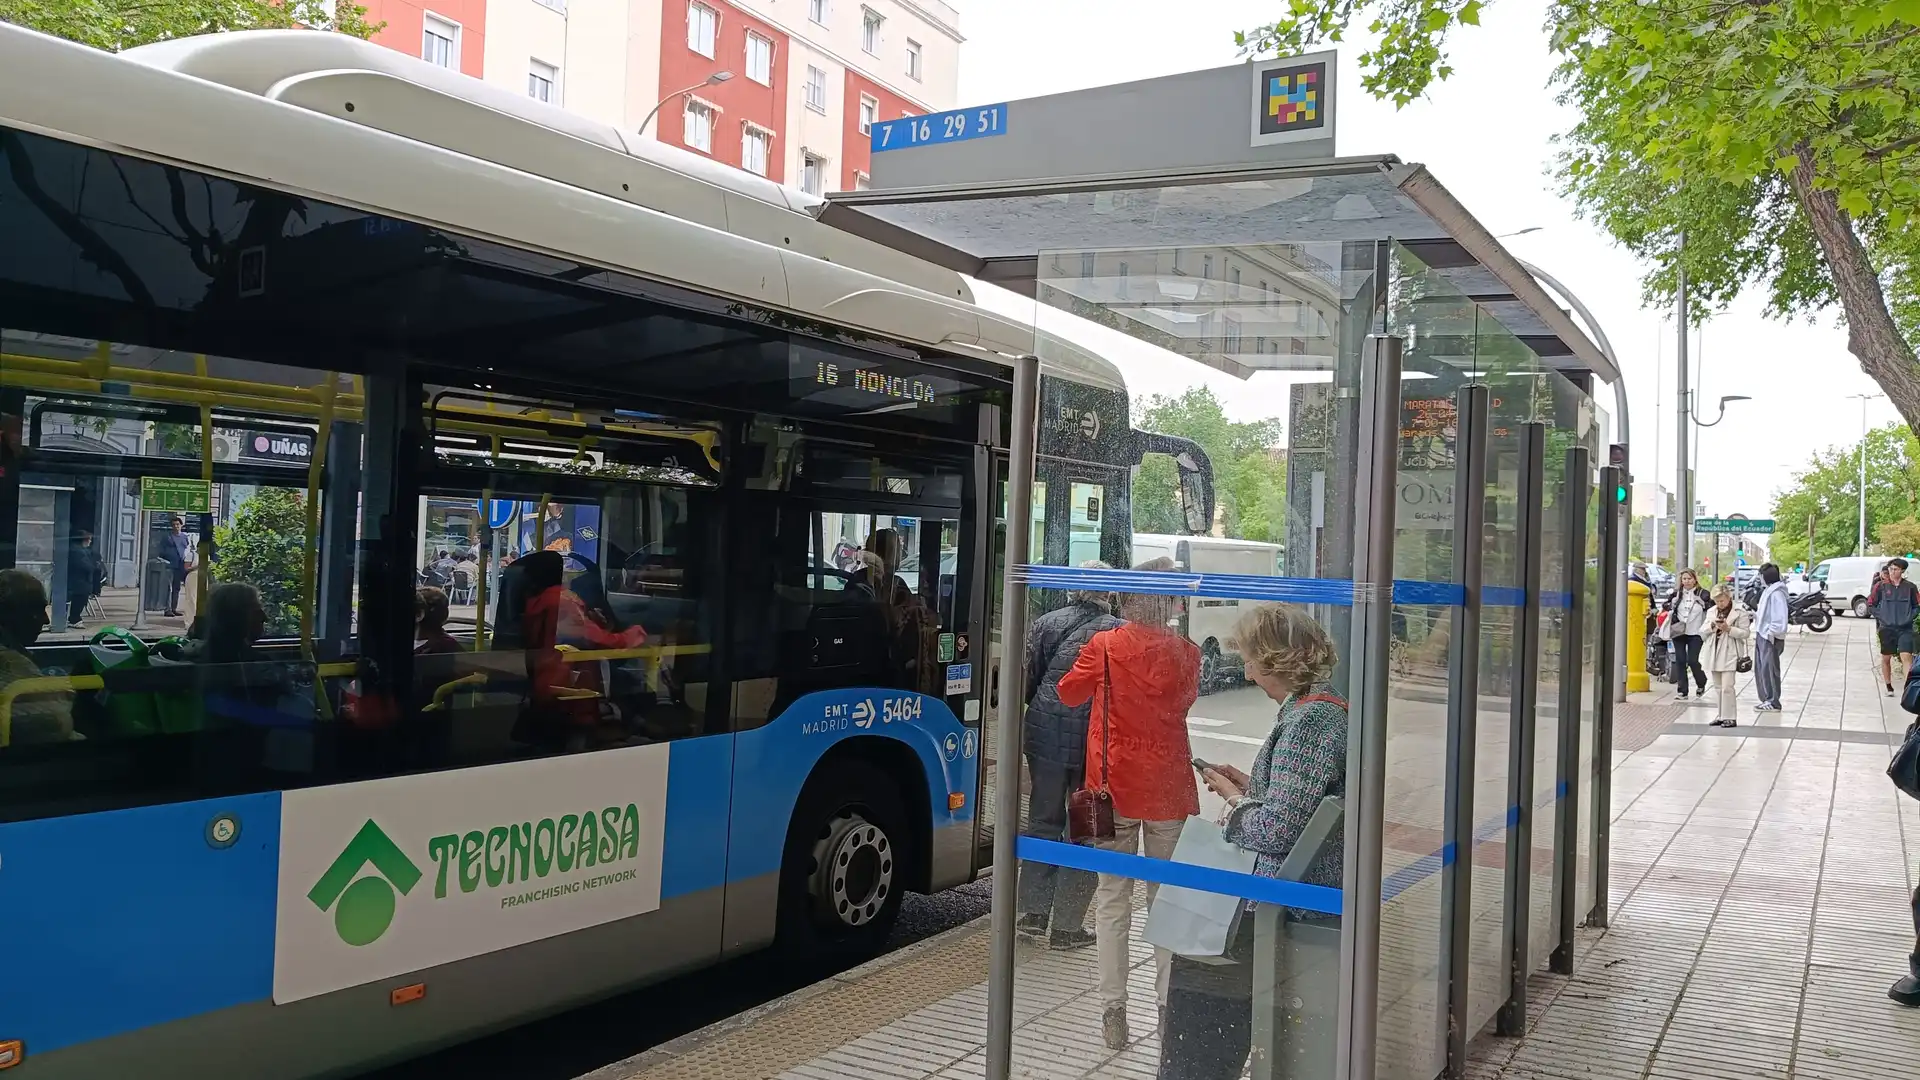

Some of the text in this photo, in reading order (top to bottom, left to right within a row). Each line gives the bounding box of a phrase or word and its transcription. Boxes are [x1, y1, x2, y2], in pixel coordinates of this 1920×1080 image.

[881, 109, 998, 147] 7 16 29 51
[817, 362, 935, 403] 16 MONCLOA
[1060, 407, 1080, 421] EMT
[1044, 418, 1080, 434] MADRID
[1743, 525, 1772, 533] Ecuador
[833, 637, 844, 645] GAS
[825, 696, 922, 723] EMT 5464
[802, 718, 848, 735] MADRID
[428, 803, 640, 899] TECNOCASA
[501, 869, 637, 909] FRANCHISING NETWORK
